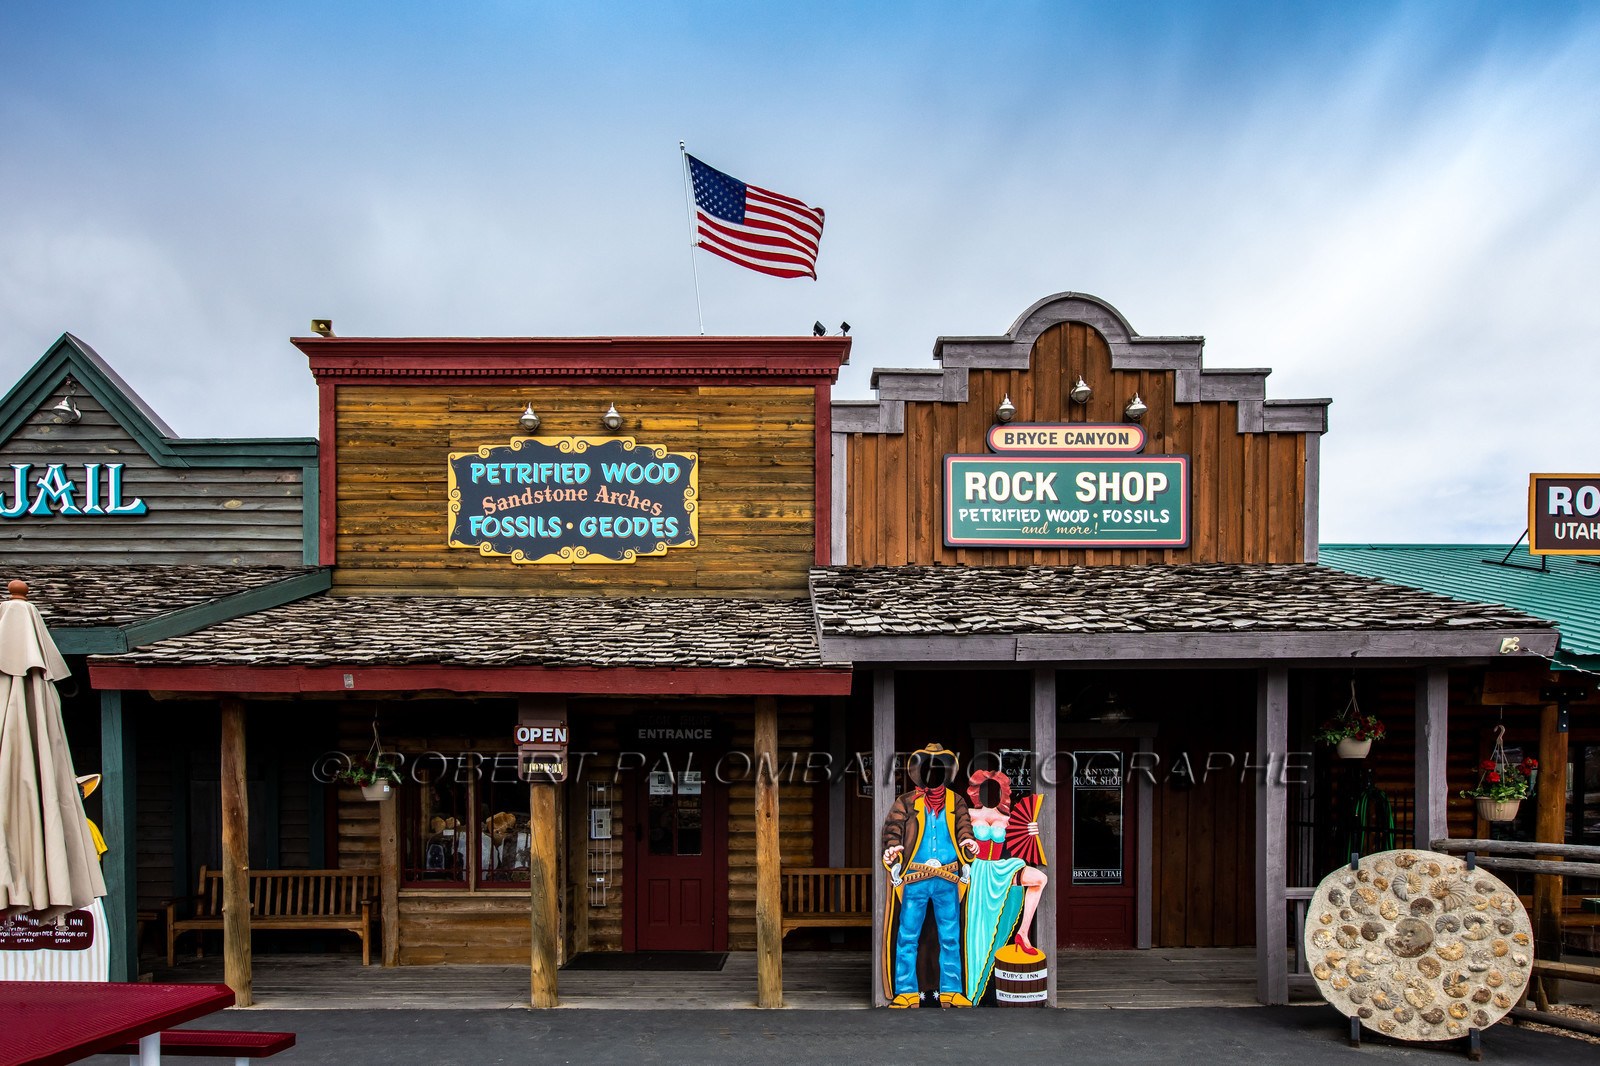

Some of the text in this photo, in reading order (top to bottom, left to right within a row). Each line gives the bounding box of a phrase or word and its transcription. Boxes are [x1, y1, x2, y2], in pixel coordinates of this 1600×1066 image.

[1004, 432, 1129, 445] BRYCE CANYON
[470, 462, 681, 485] PETRIFIED WOOD
[0, 463, 148, 517] JAIL
[964, 470, 1168, 503] ROCK SHOP
[482, 485, 663, 516] Sandstone Arches
[1548, 485, 1600, 517] RO
[958, 508, 1170, 524] PETRIFIED WOOD FOSSILS
[469, 516, 679, 538] FOSSILS GEODES
[1021, 521, 1099, 535] and more!
[1554, 522, 1600, 540] UTAH
[516, 727, 567, 742] OPEN
[638, 728, 712, 739] ENTRANCE
[1074, 776, 1097, 786] ROCK
[69, 918, 83, 926] INN
